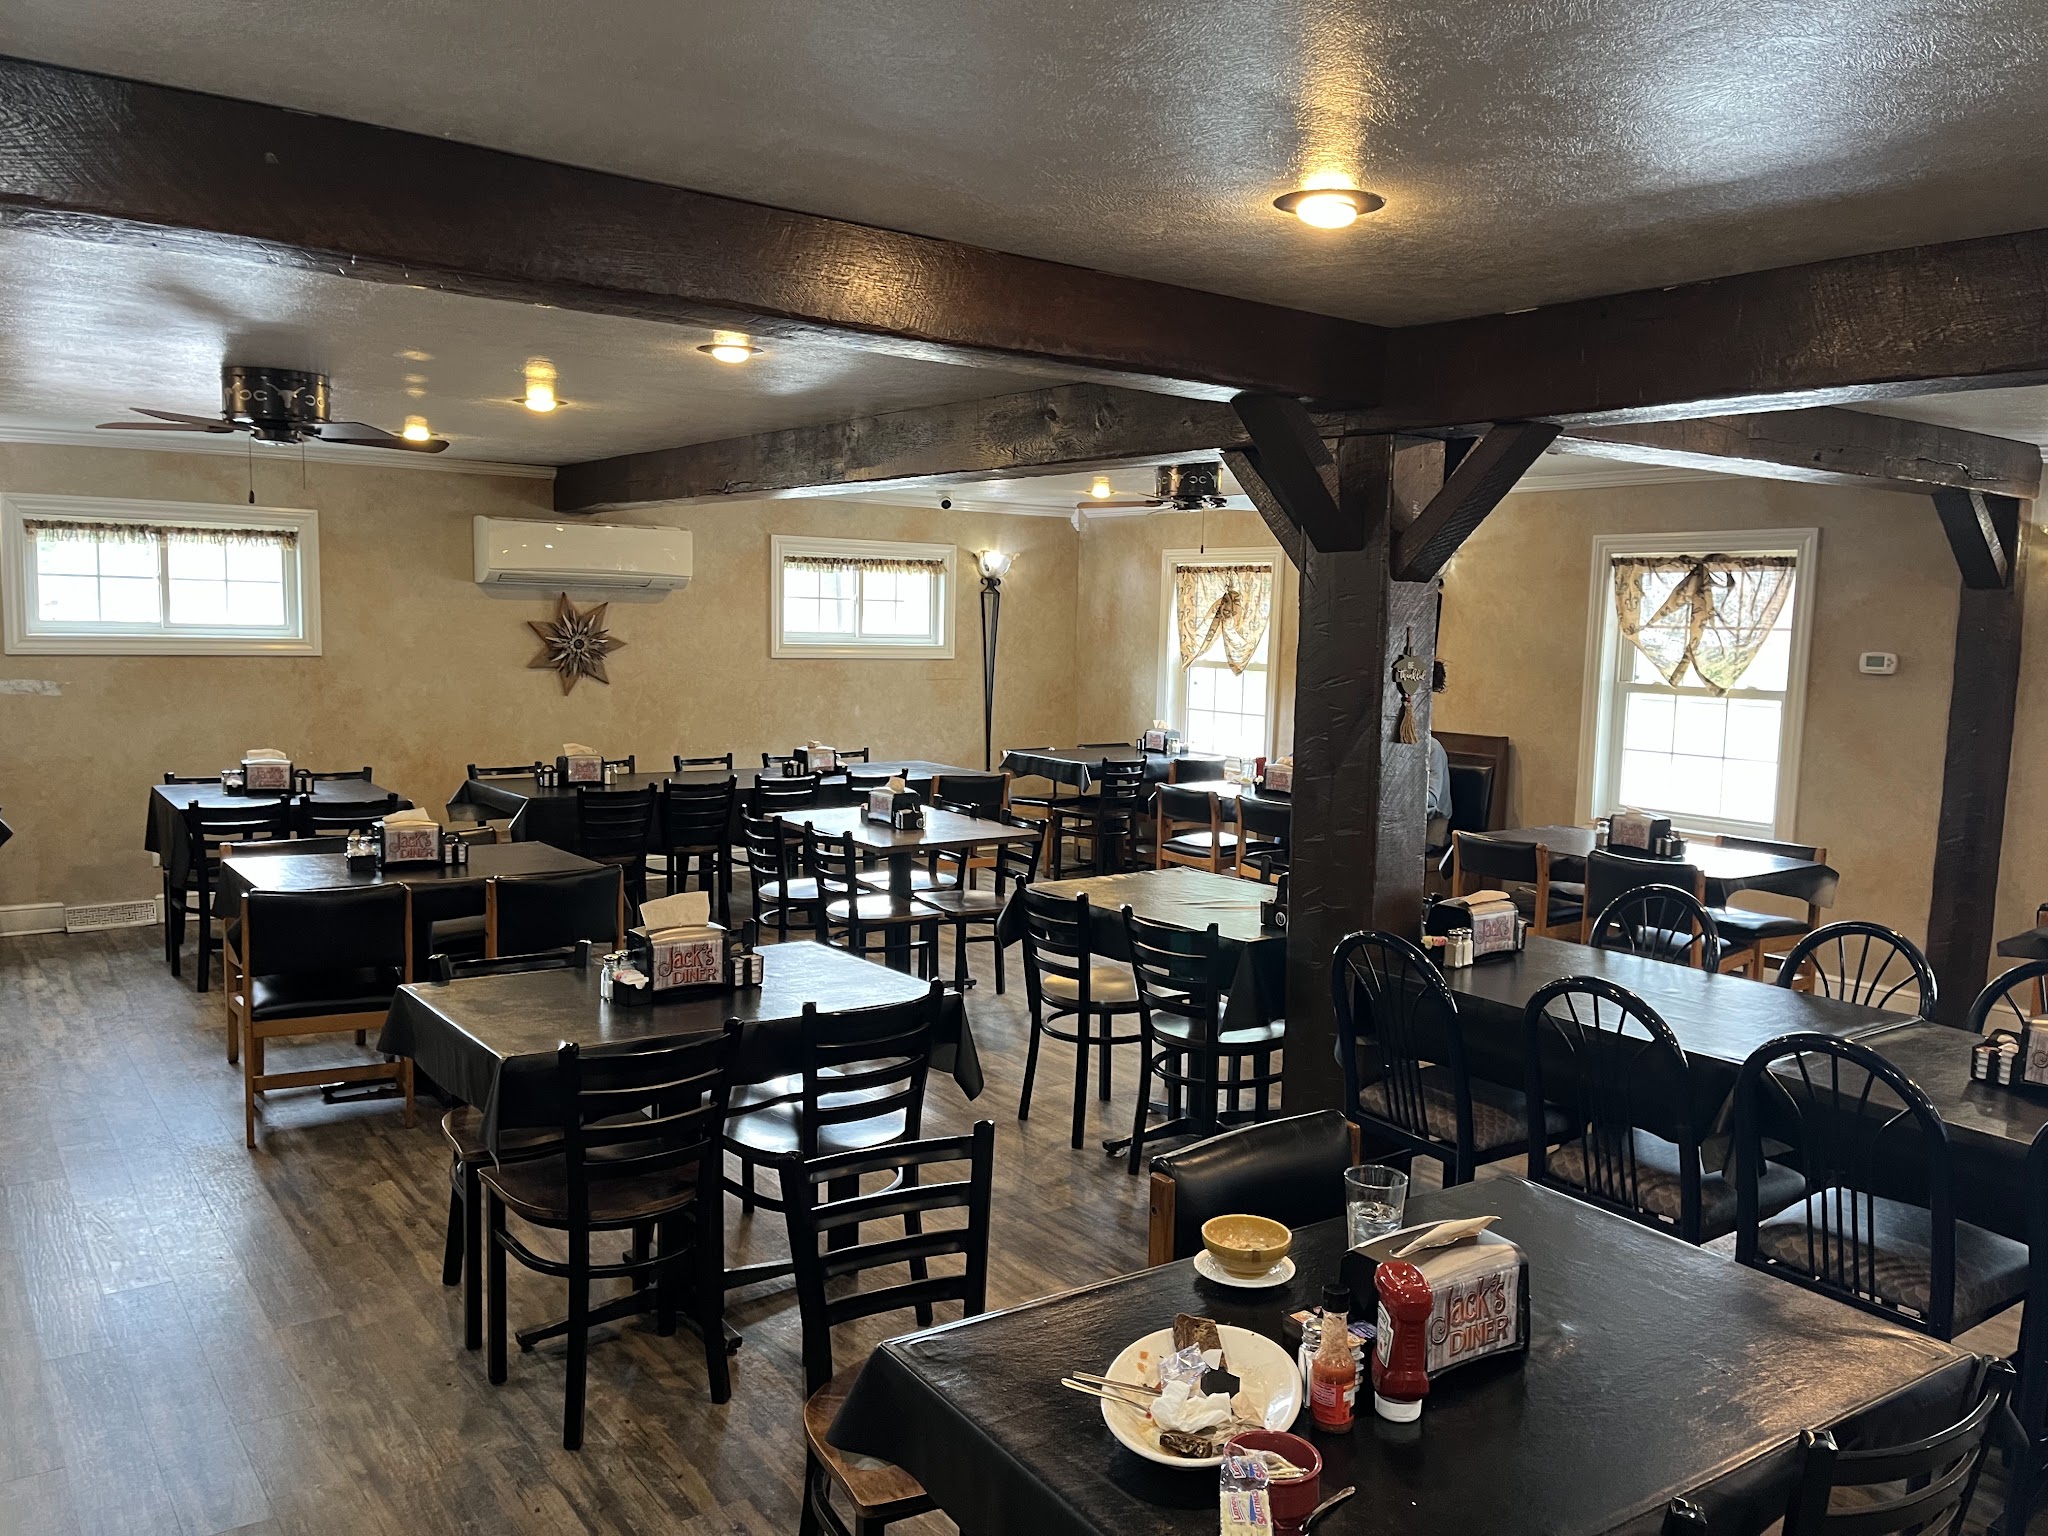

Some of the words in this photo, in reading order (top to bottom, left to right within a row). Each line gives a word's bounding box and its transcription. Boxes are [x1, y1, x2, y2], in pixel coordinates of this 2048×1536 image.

[389, 831, 431, 853] Jack's
[659, 943, 715, 977] Jack's
[672, 967, 717, 985] DINER
[1430, 1272, 1506, 1345] Jack's
[1449, 1315, 1508, 1357] DINER
[1251, 1490, 1268, 1525] SALTINES
